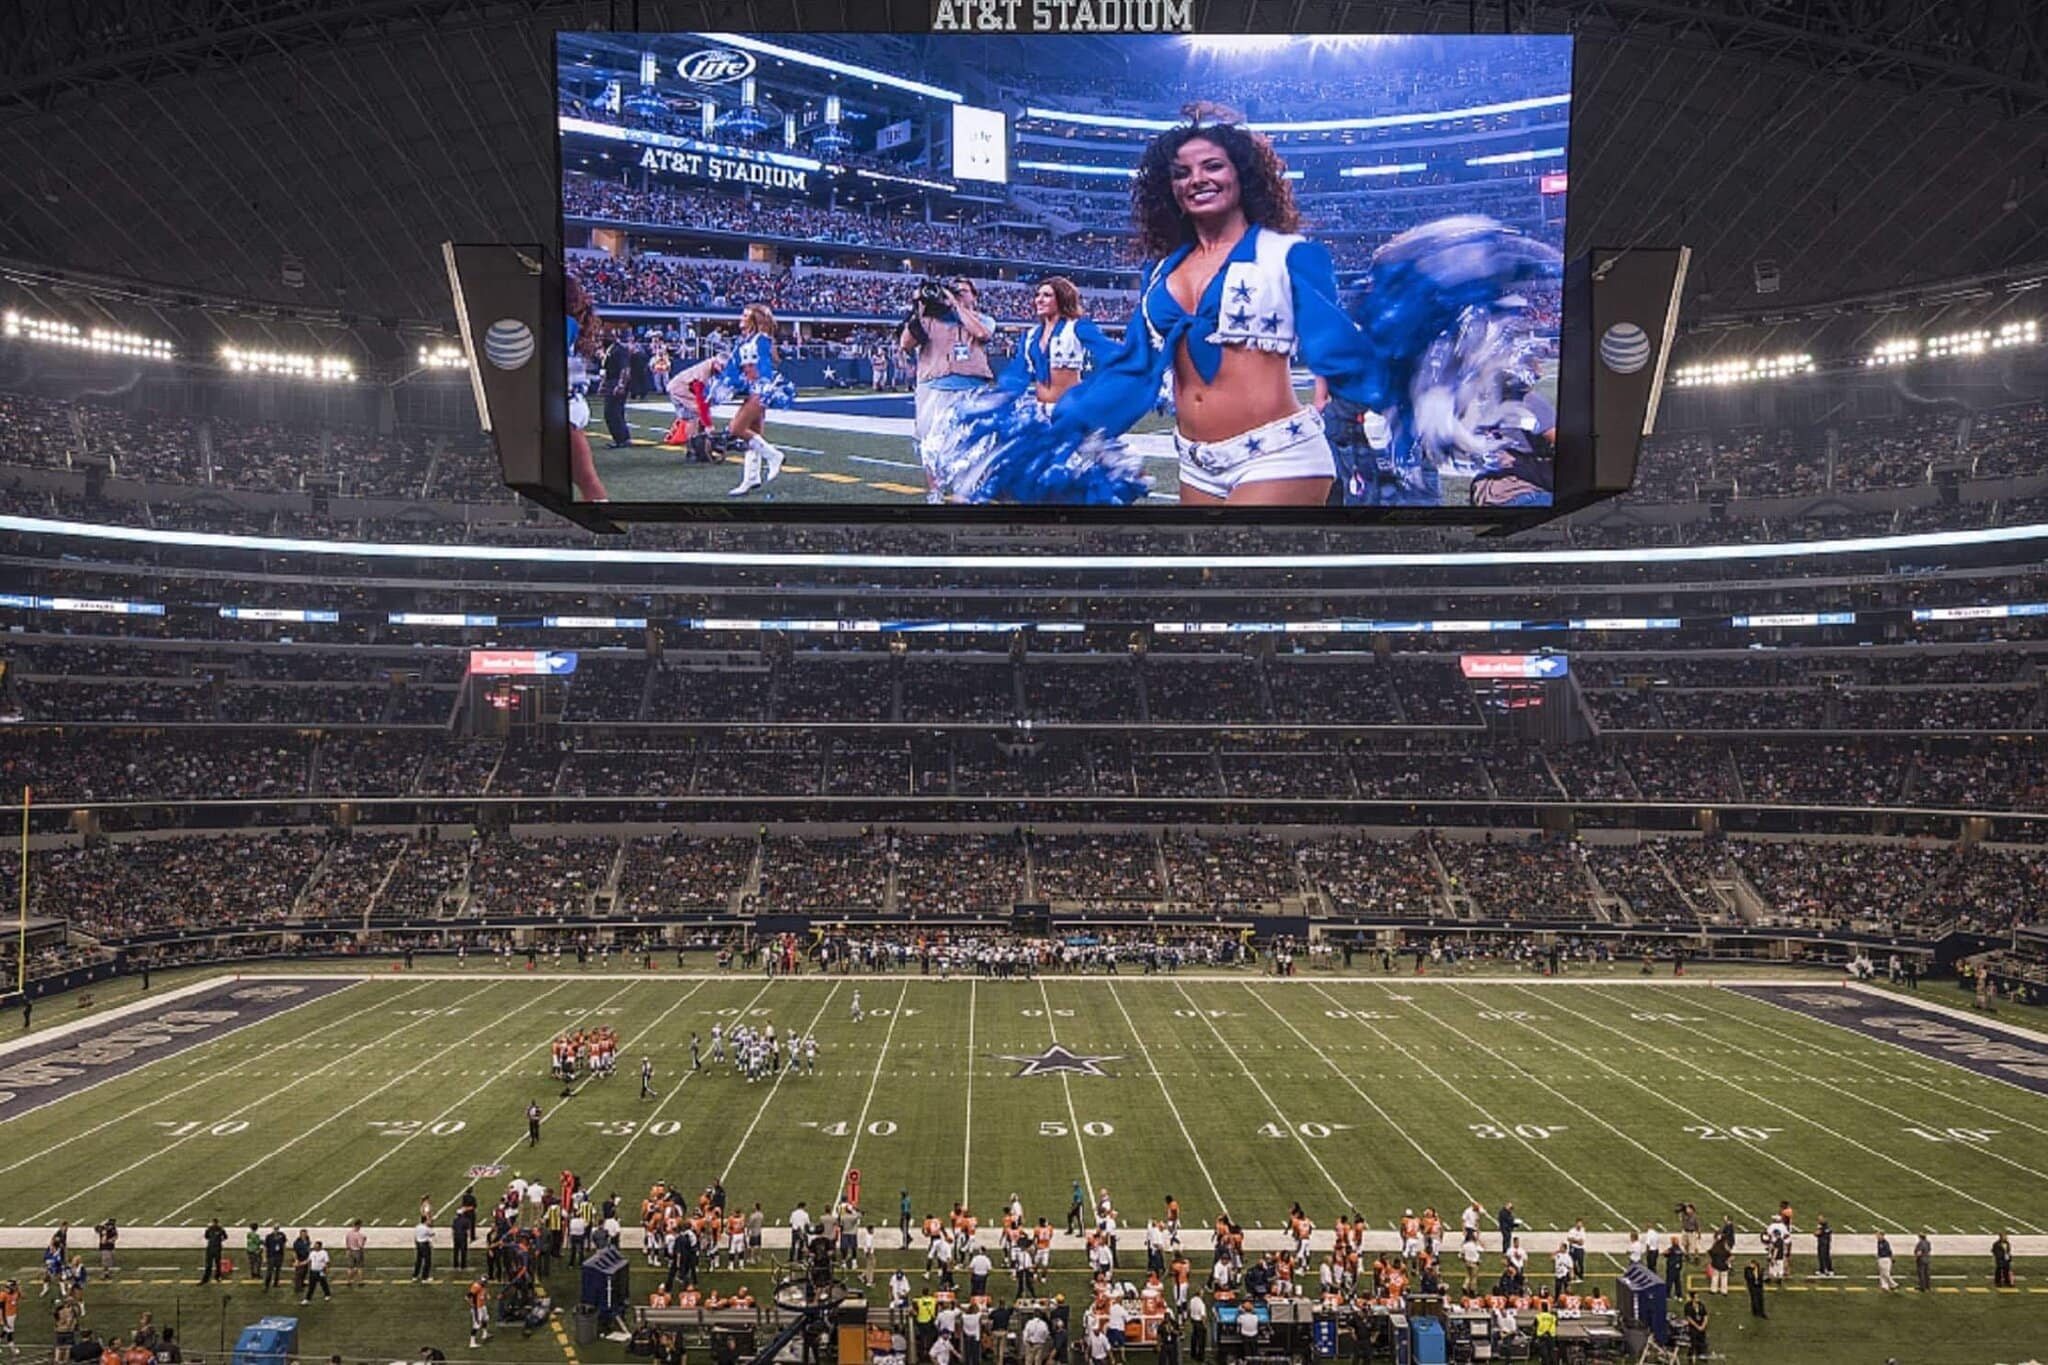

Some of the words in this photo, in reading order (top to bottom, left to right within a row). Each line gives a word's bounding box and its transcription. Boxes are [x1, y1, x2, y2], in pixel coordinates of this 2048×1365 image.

[933, 0, 1022, 31] AT&T
[1032, 0, 1193, 31] STADIUM
[690, 59, 746, 80] Lite
[639, 147, 703, 175] AT&T
[708, 156, 807, 190] STADIUM
[166, 1121, 250, 1136] 10
[380, 1121, 467, 1136] 20
[601, 1121, 681, 1136] 30
[821, 1121, 898, 1136] 40
[1038, 1121, 1115, 1136] 50
[1257, 1122, 1331, 1138] 40
[1468, 1123, 1550, 1139] 30
[1683, 1126, 1769, 1141] 20
